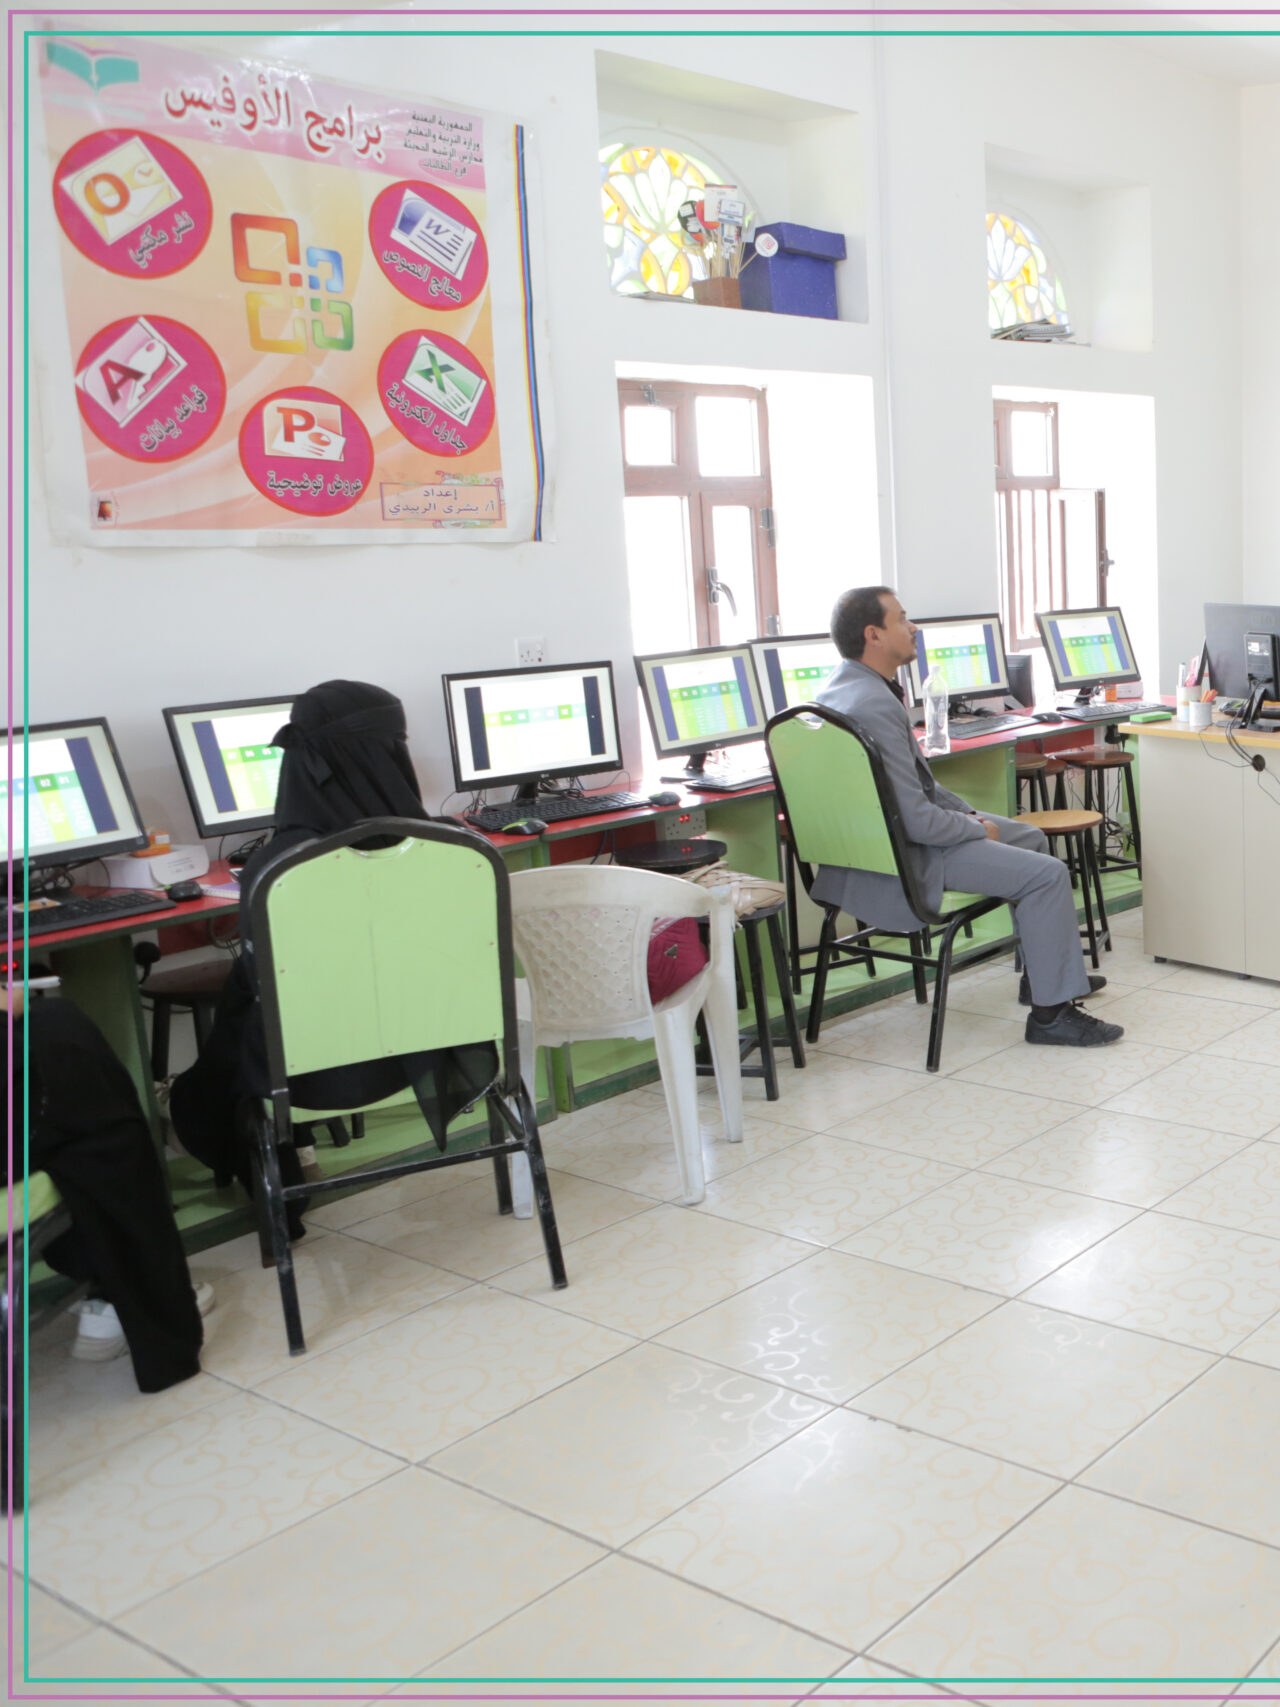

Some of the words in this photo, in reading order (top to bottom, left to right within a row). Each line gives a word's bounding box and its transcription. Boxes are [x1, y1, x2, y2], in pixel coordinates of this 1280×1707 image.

[164, 73, 291, 130] الأوفيس
[304, 103, 383, 159] برامج
[128, 225, 168, 269] مكتبي
[383, 250, 431, 282] النصوص
[100, 359, 146, 405] A
[139, 418, 182, 452] بيانات
[276, 406, 315, 443] P
[433, 421, 468, 455] جداول
[267, 470, 324, 497] توضيحية
[328, 474, 363, 496] عروض
[423, 488, 458, 500] إعداد
